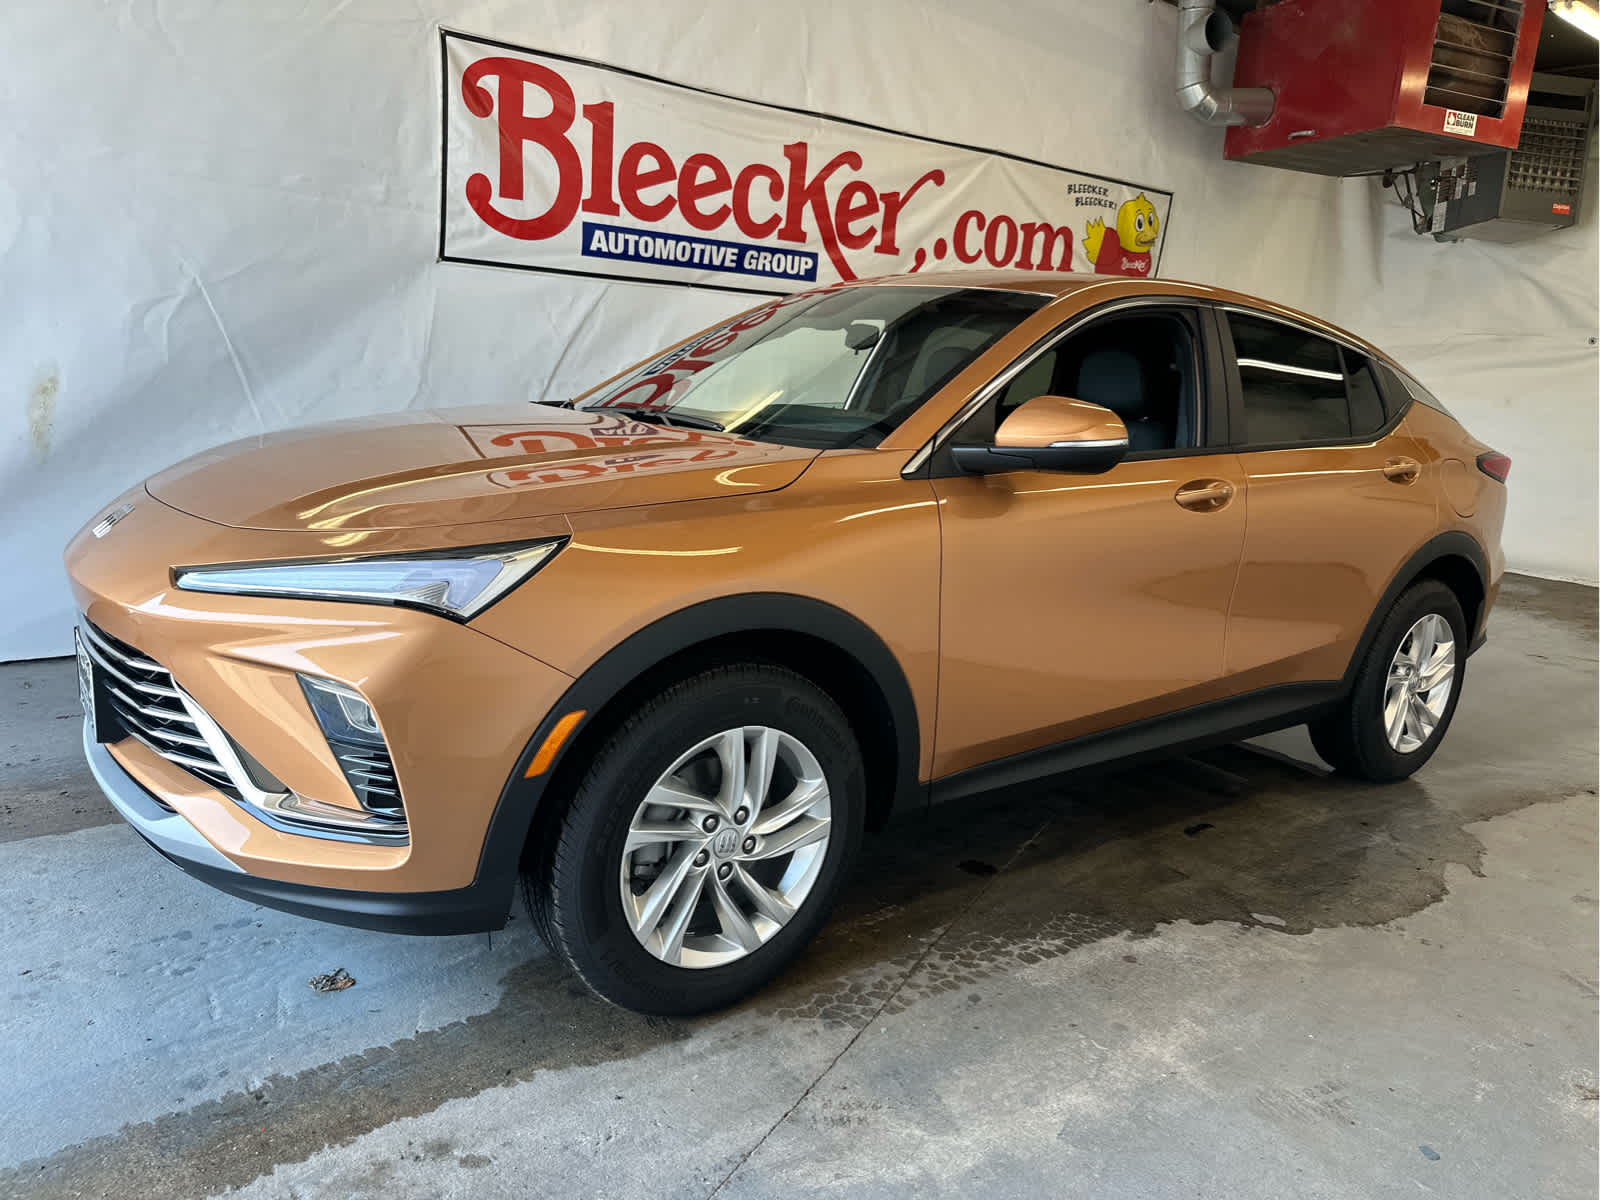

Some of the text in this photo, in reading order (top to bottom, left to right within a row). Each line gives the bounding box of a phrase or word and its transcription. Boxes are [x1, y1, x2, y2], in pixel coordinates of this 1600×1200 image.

[1456, 113, 1475, 121] CLEAN
[1456, 120, 1473, 129] BURN
[590, 229, 814, 276] AUTOMOTIVE GROUP
